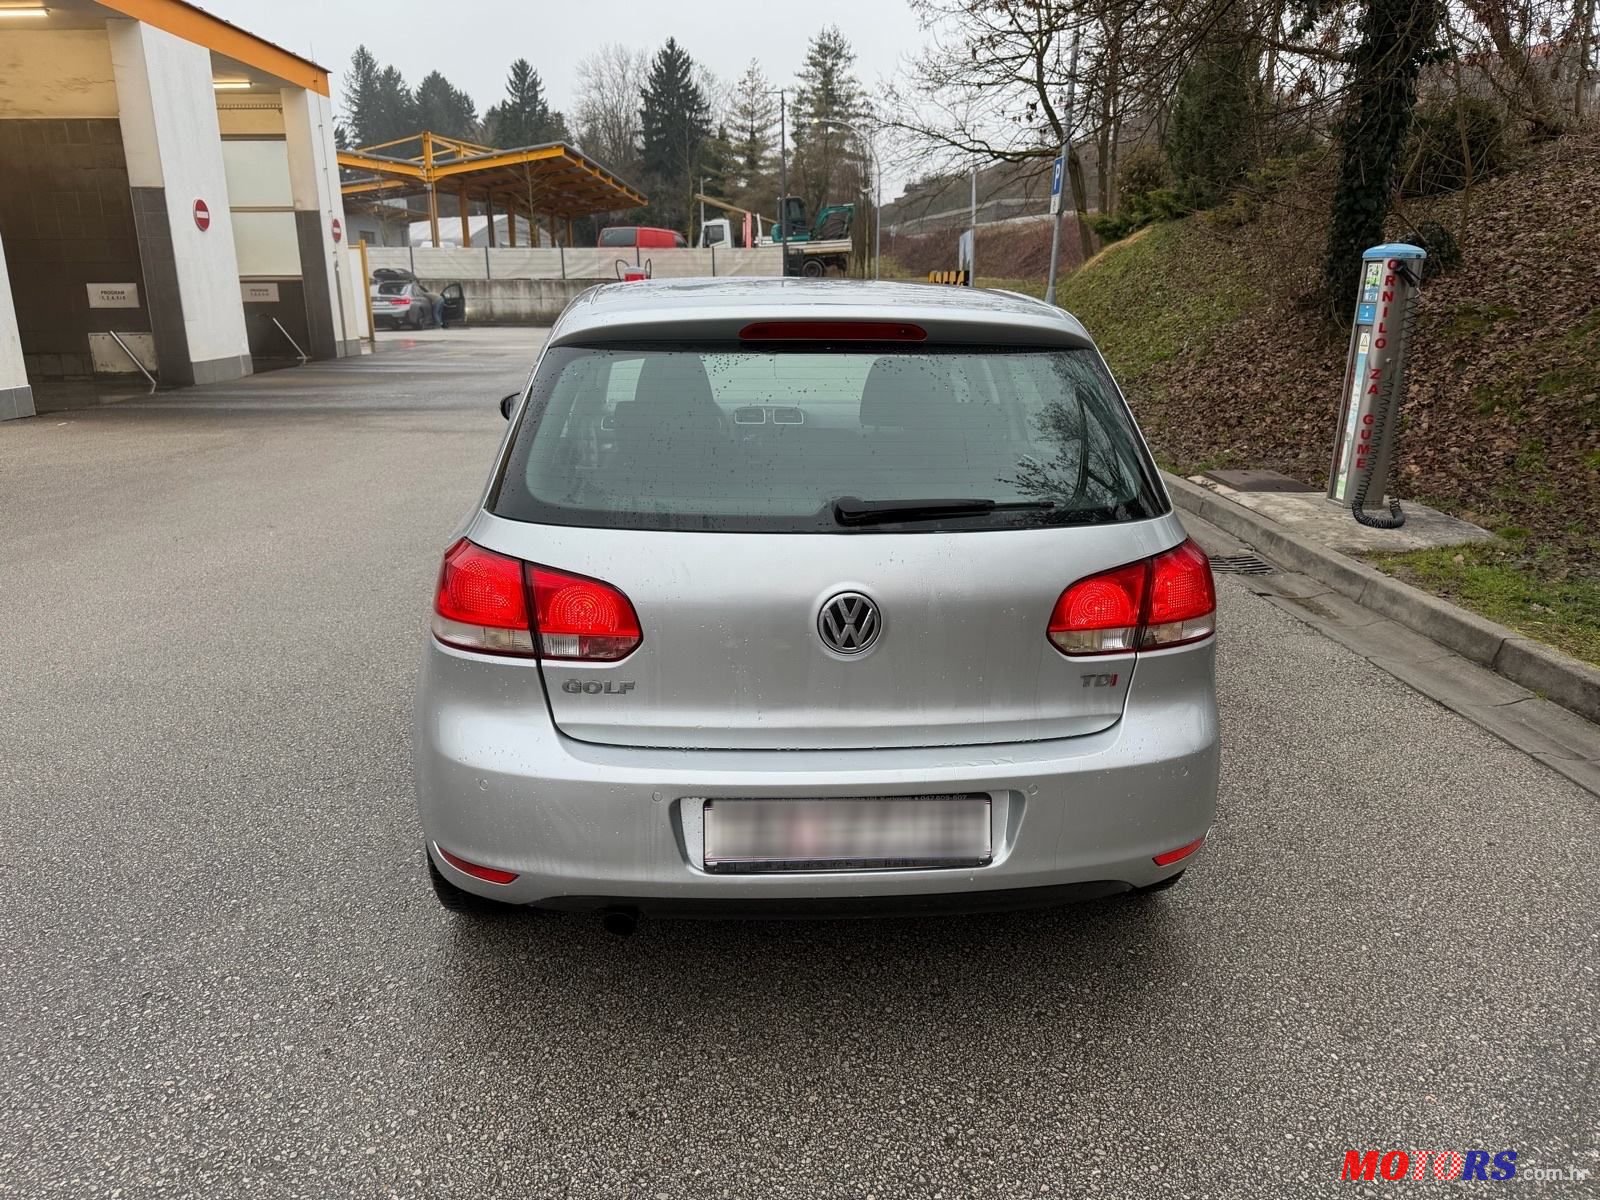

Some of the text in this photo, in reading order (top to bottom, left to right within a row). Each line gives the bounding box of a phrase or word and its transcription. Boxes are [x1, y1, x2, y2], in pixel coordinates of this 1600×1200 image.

[1053, 163, 1061, 190] P
[1367, 368, 1382, 395] ZA
[1356, 414, 1375, 468] GUME
[561, 678, 636, 695] GOLF
[1080, 673, 1119, 688] TDI
